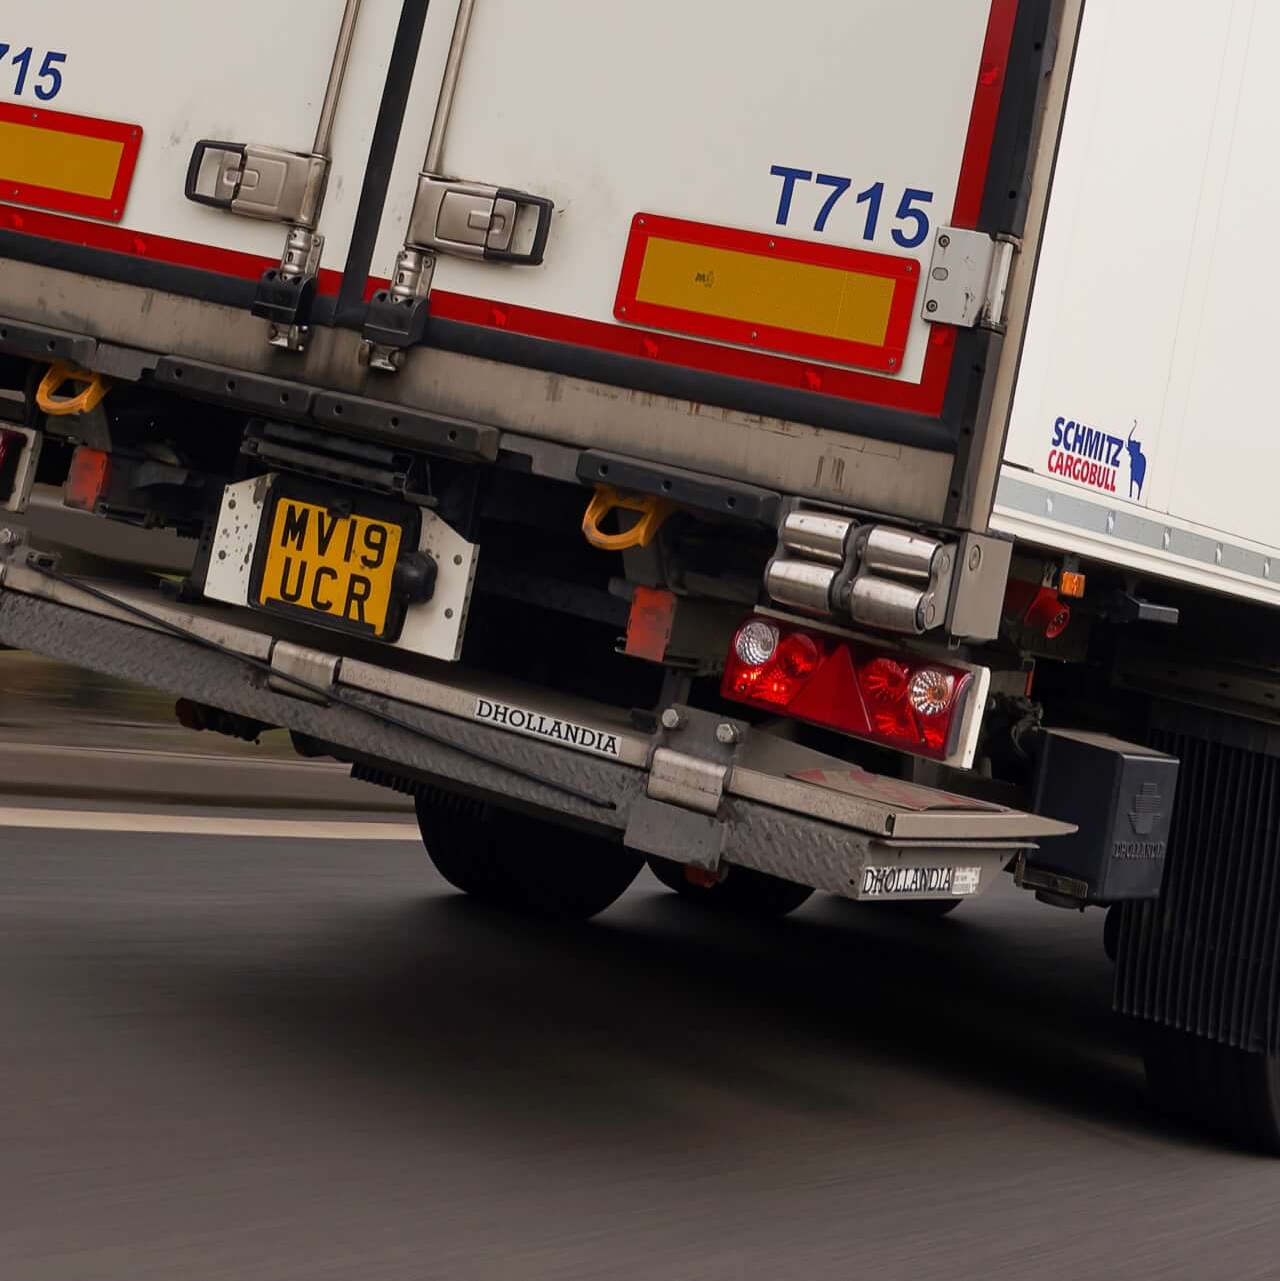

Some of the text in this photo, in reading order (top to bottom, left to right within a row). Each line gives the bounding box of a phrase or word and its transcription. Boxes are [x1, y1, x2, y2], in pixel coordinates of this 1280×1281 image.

[770, 164, 933, 249] T715
[1052, 416, 1124, 468] SCHMITZ
[1047, 449, 1116, 493] CARGOBULL
[280, 503, 388, 569] MV19
[279, 556, 372, 623] UCR
[476, 699, 618, 755] DHOLLANDIA
[862, 867, 953, 894] DHOLLANDIA
